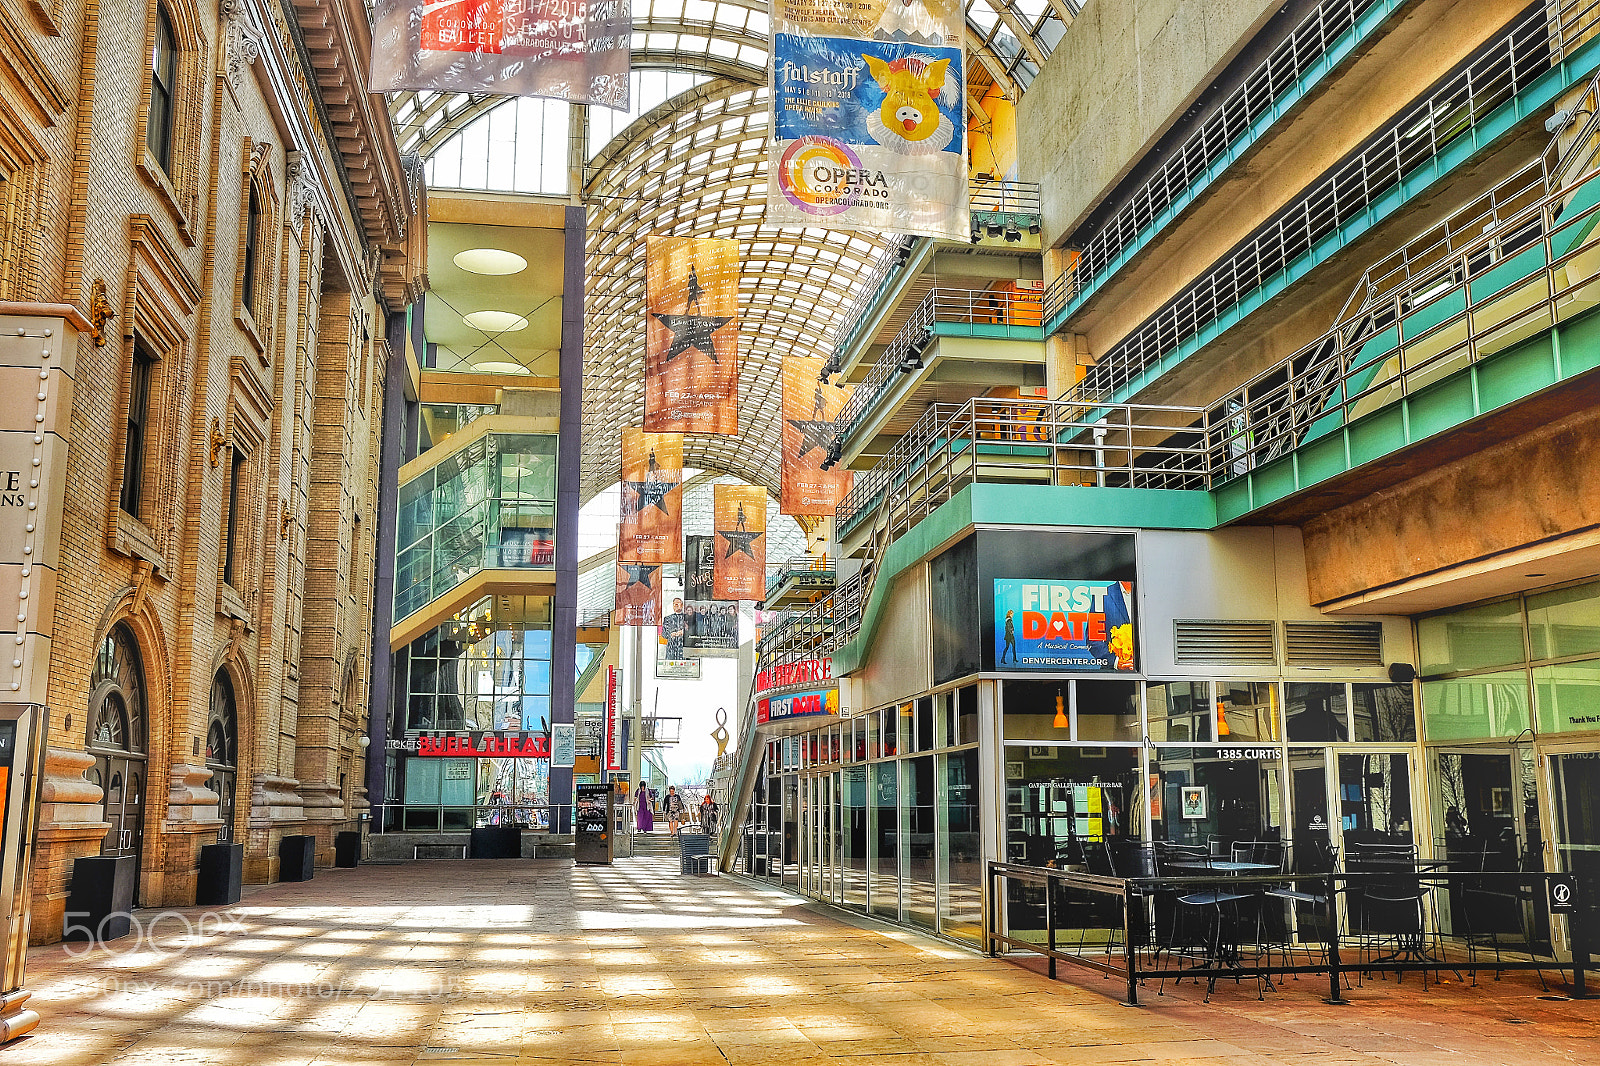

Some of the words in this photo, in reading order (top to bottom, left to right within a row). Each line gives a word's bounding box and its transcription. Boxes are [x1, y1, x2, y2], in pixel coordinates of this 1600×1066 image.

[439, 18, 495, 31] COLORADO
[438, 29, 495, 45] BALLET
[781, 60, 864, 91] falstaff
[796, 98, 812, 106] ELLIE
[814, 166, 888, 188] OPERA
[814, 184, 889, 198] COLORADO
[815, 196, 889, 210] OPERACOLORADO.ORG
[1022, 584, 1108, 612] FIRST
[1022, 611, 1107, 641] DATE
[1038, 641, 1043, 649] A
[1044, 642, 1069, 650] Musical
[1022, 657, 1108, 666] DENVERCENTER.ORG
[771, 698, 792, 718] FIRST
[793, 694, 821, 714] DATE
[1569, 716, 1586, 724] Thank
[1586, 715, 1596, 723] You
[385, 739, 422, 750] TICKETS
[419, 736, 473, 752] BUELL
[483, 737, 552, 754] THEAT
[1216, 749, 1242, 759] 1385
[1244, 749, 1282, 759] CURTIS
